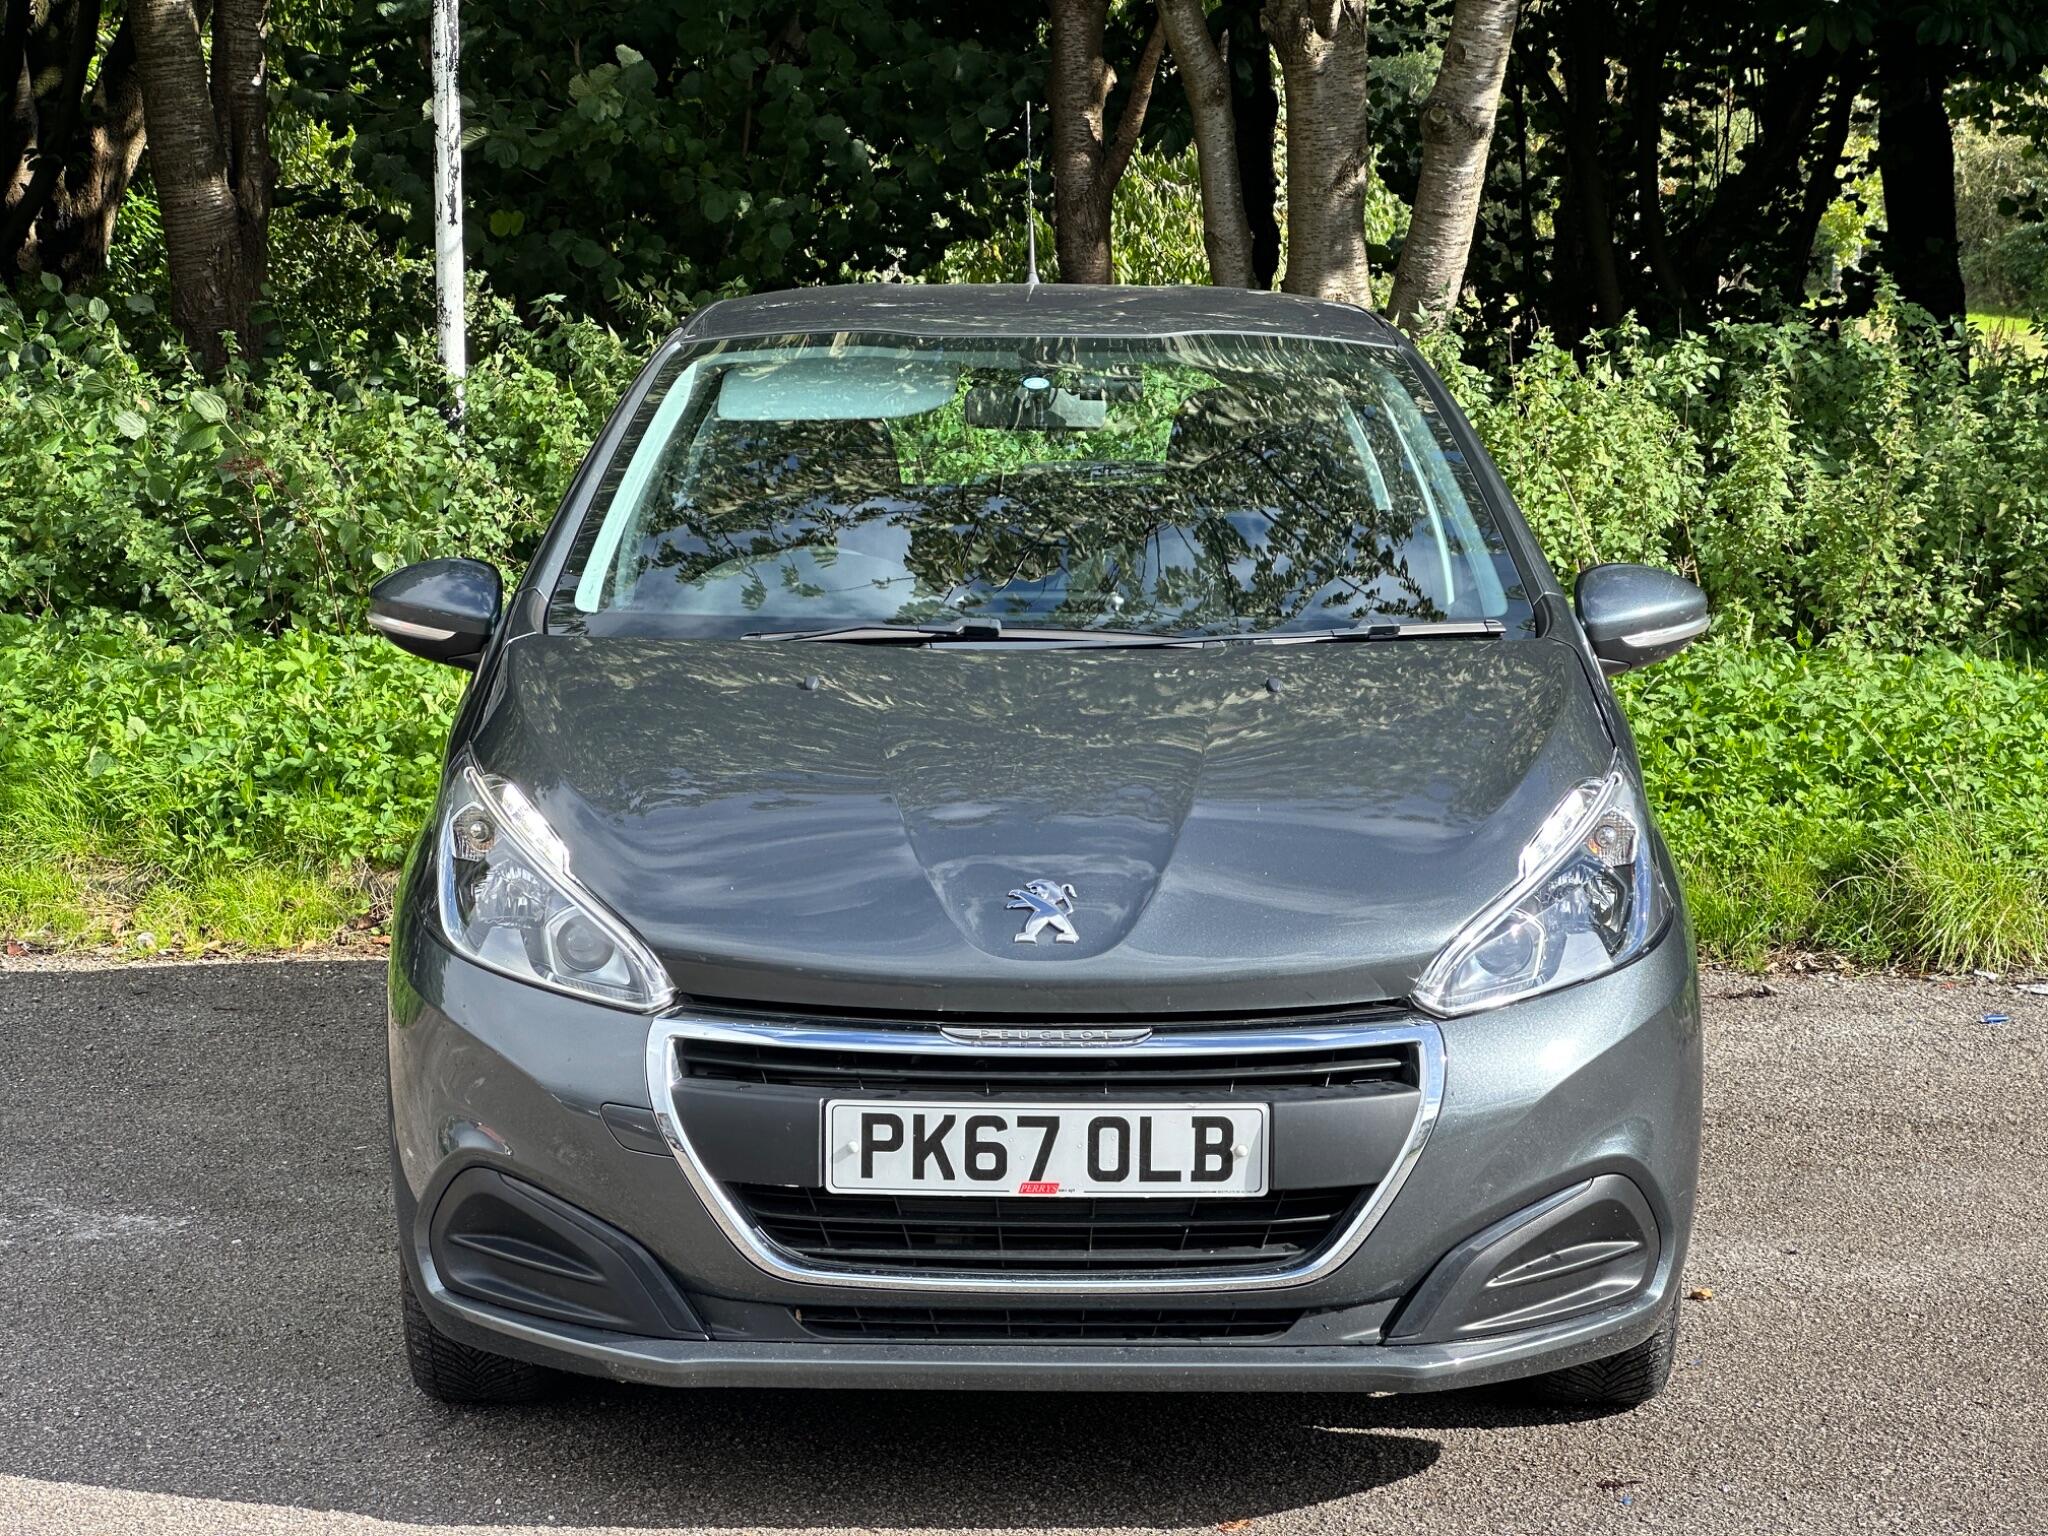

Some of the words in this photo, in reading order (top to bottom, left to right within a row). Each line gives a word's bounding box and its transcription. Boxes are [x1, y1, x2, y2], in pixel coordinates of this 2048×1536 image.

[979, 1030, 1113, 1040] PEUGEOT
[861, 1113, 1060, 1181] PK67
[1087, 1115, 1234, 1183] OLB
[1020, 1183, 1058, 1194] PERRYS
